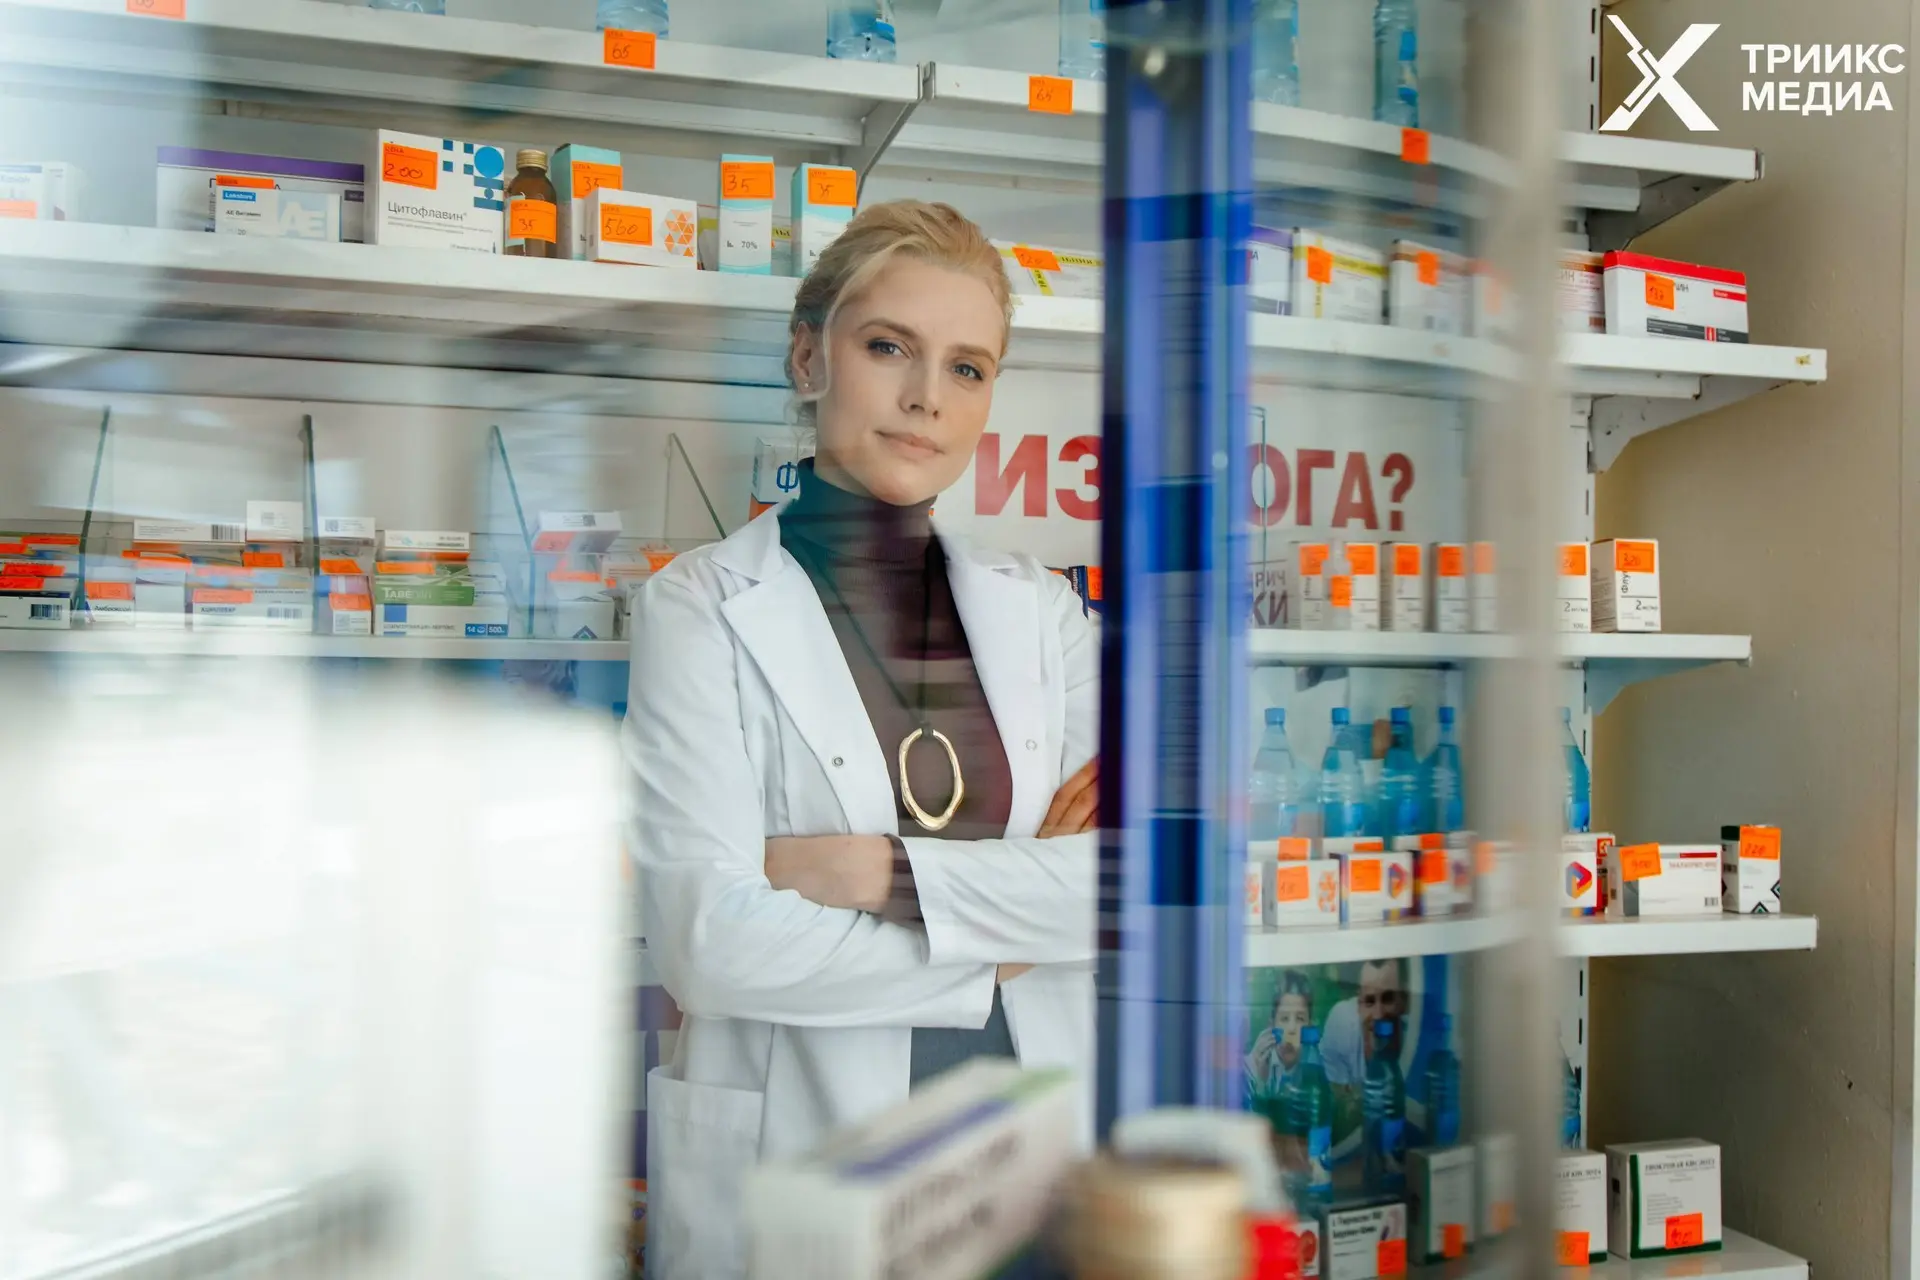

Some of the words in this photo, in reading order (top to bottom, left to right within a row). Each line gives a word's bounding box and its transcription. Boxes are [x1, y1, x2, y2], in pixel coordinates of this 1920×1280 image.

[384, 163, 424, 179] 200
[725, 174, 757, 193] 35
[387, 201, 464, 222] Цитофлавин
[519, 219, 537, 231] 35
[604, 218, 639, 236] 560
[741, 240, 758, 249] 70%
[776, 461, 799, 493] Ф
[1252, 570, 1287, 589] РИЧ
[1621, 570, 1631, 594] Флу
[1252, 590, 1289, 627] КИ
